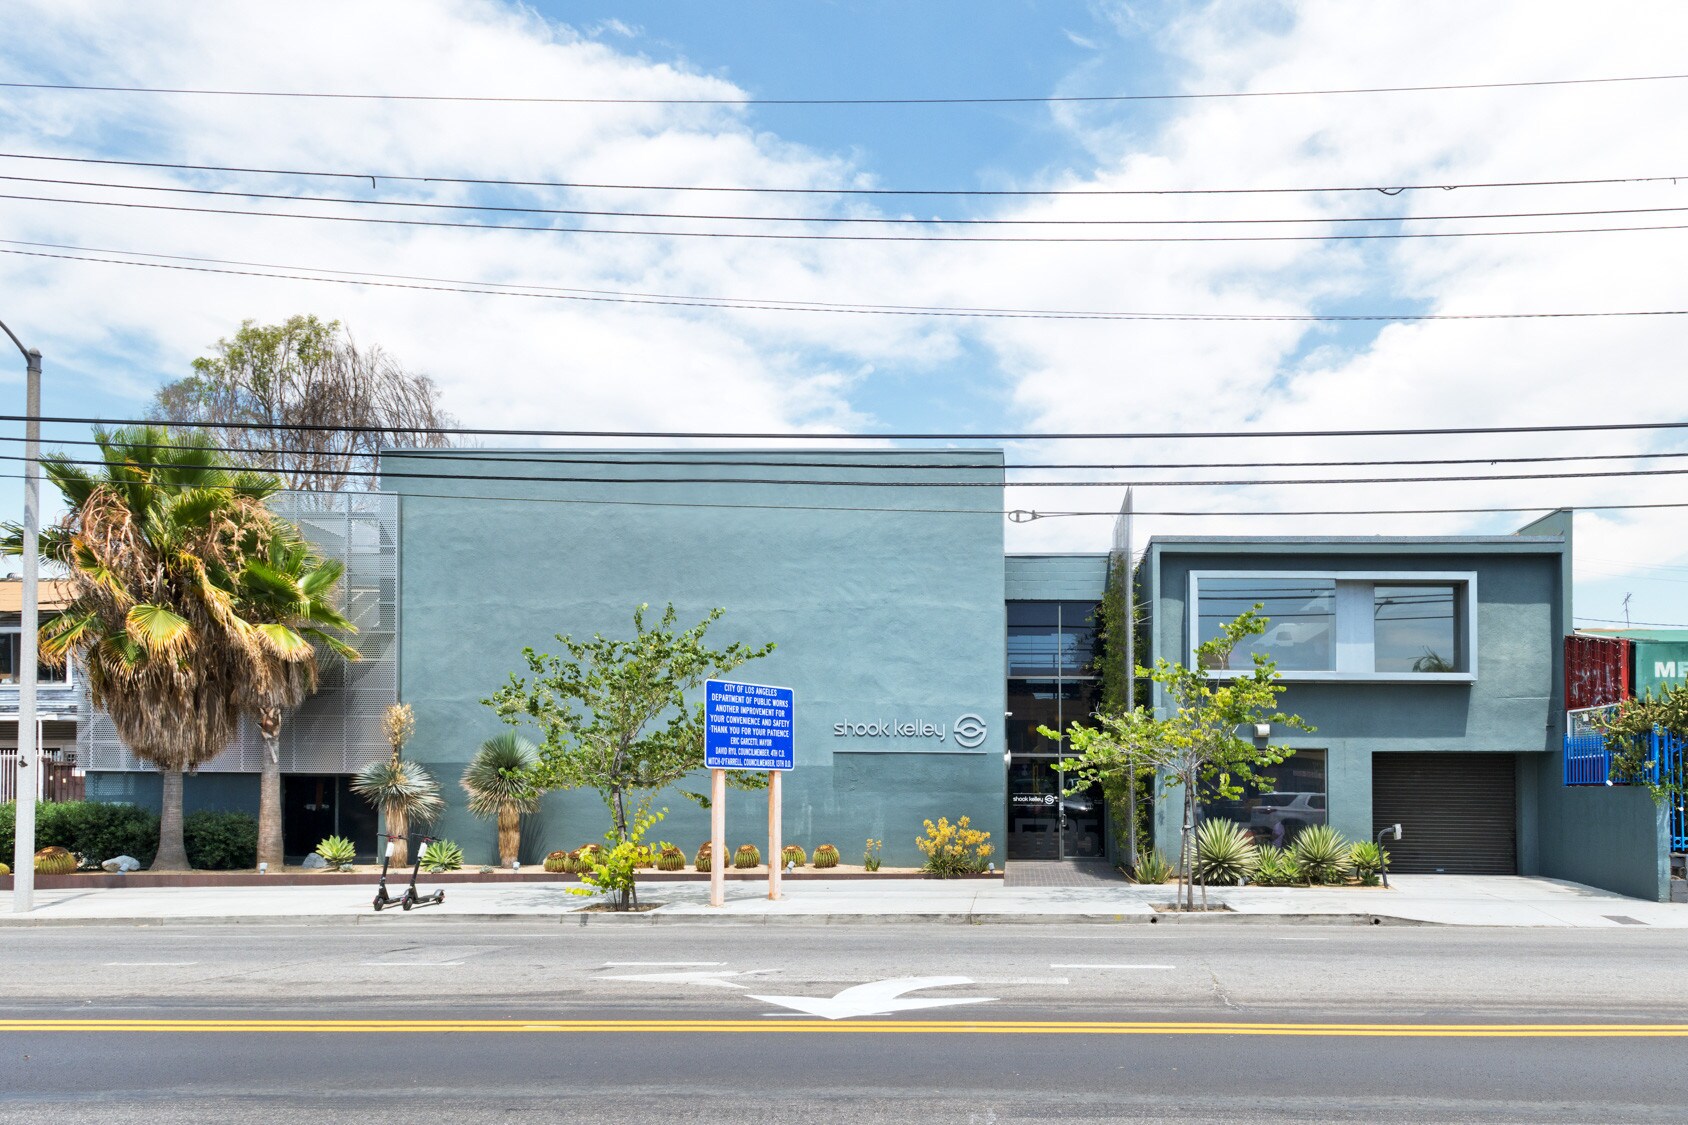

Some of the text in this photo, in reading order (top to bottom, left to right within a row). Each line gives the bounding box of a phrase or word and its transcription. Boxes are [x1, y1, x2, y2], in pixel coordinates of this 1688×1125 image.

[737, 685, 743, 693] OF
[745, 686, 754, 694] LOS
[756, 687, 777, 696] ANGELES
[712, 693, 745, 704] DEPARTMENT
[754, 698, 771, 706] PUBLIC
[773, 699, 788, 707] WORKS
[716, 705, 739, 713] ANOTHER
[741, 707, 774, 716] IMPROVEMENT
[710, 714, 724, 722] YOUR
[726, 716, 760, 725] CONVENIENCE
[711, 725, 728, 733] THANK
[767, 729, 789, 737] PATIENCE
[834, 718, 946, 742] shook kelley
